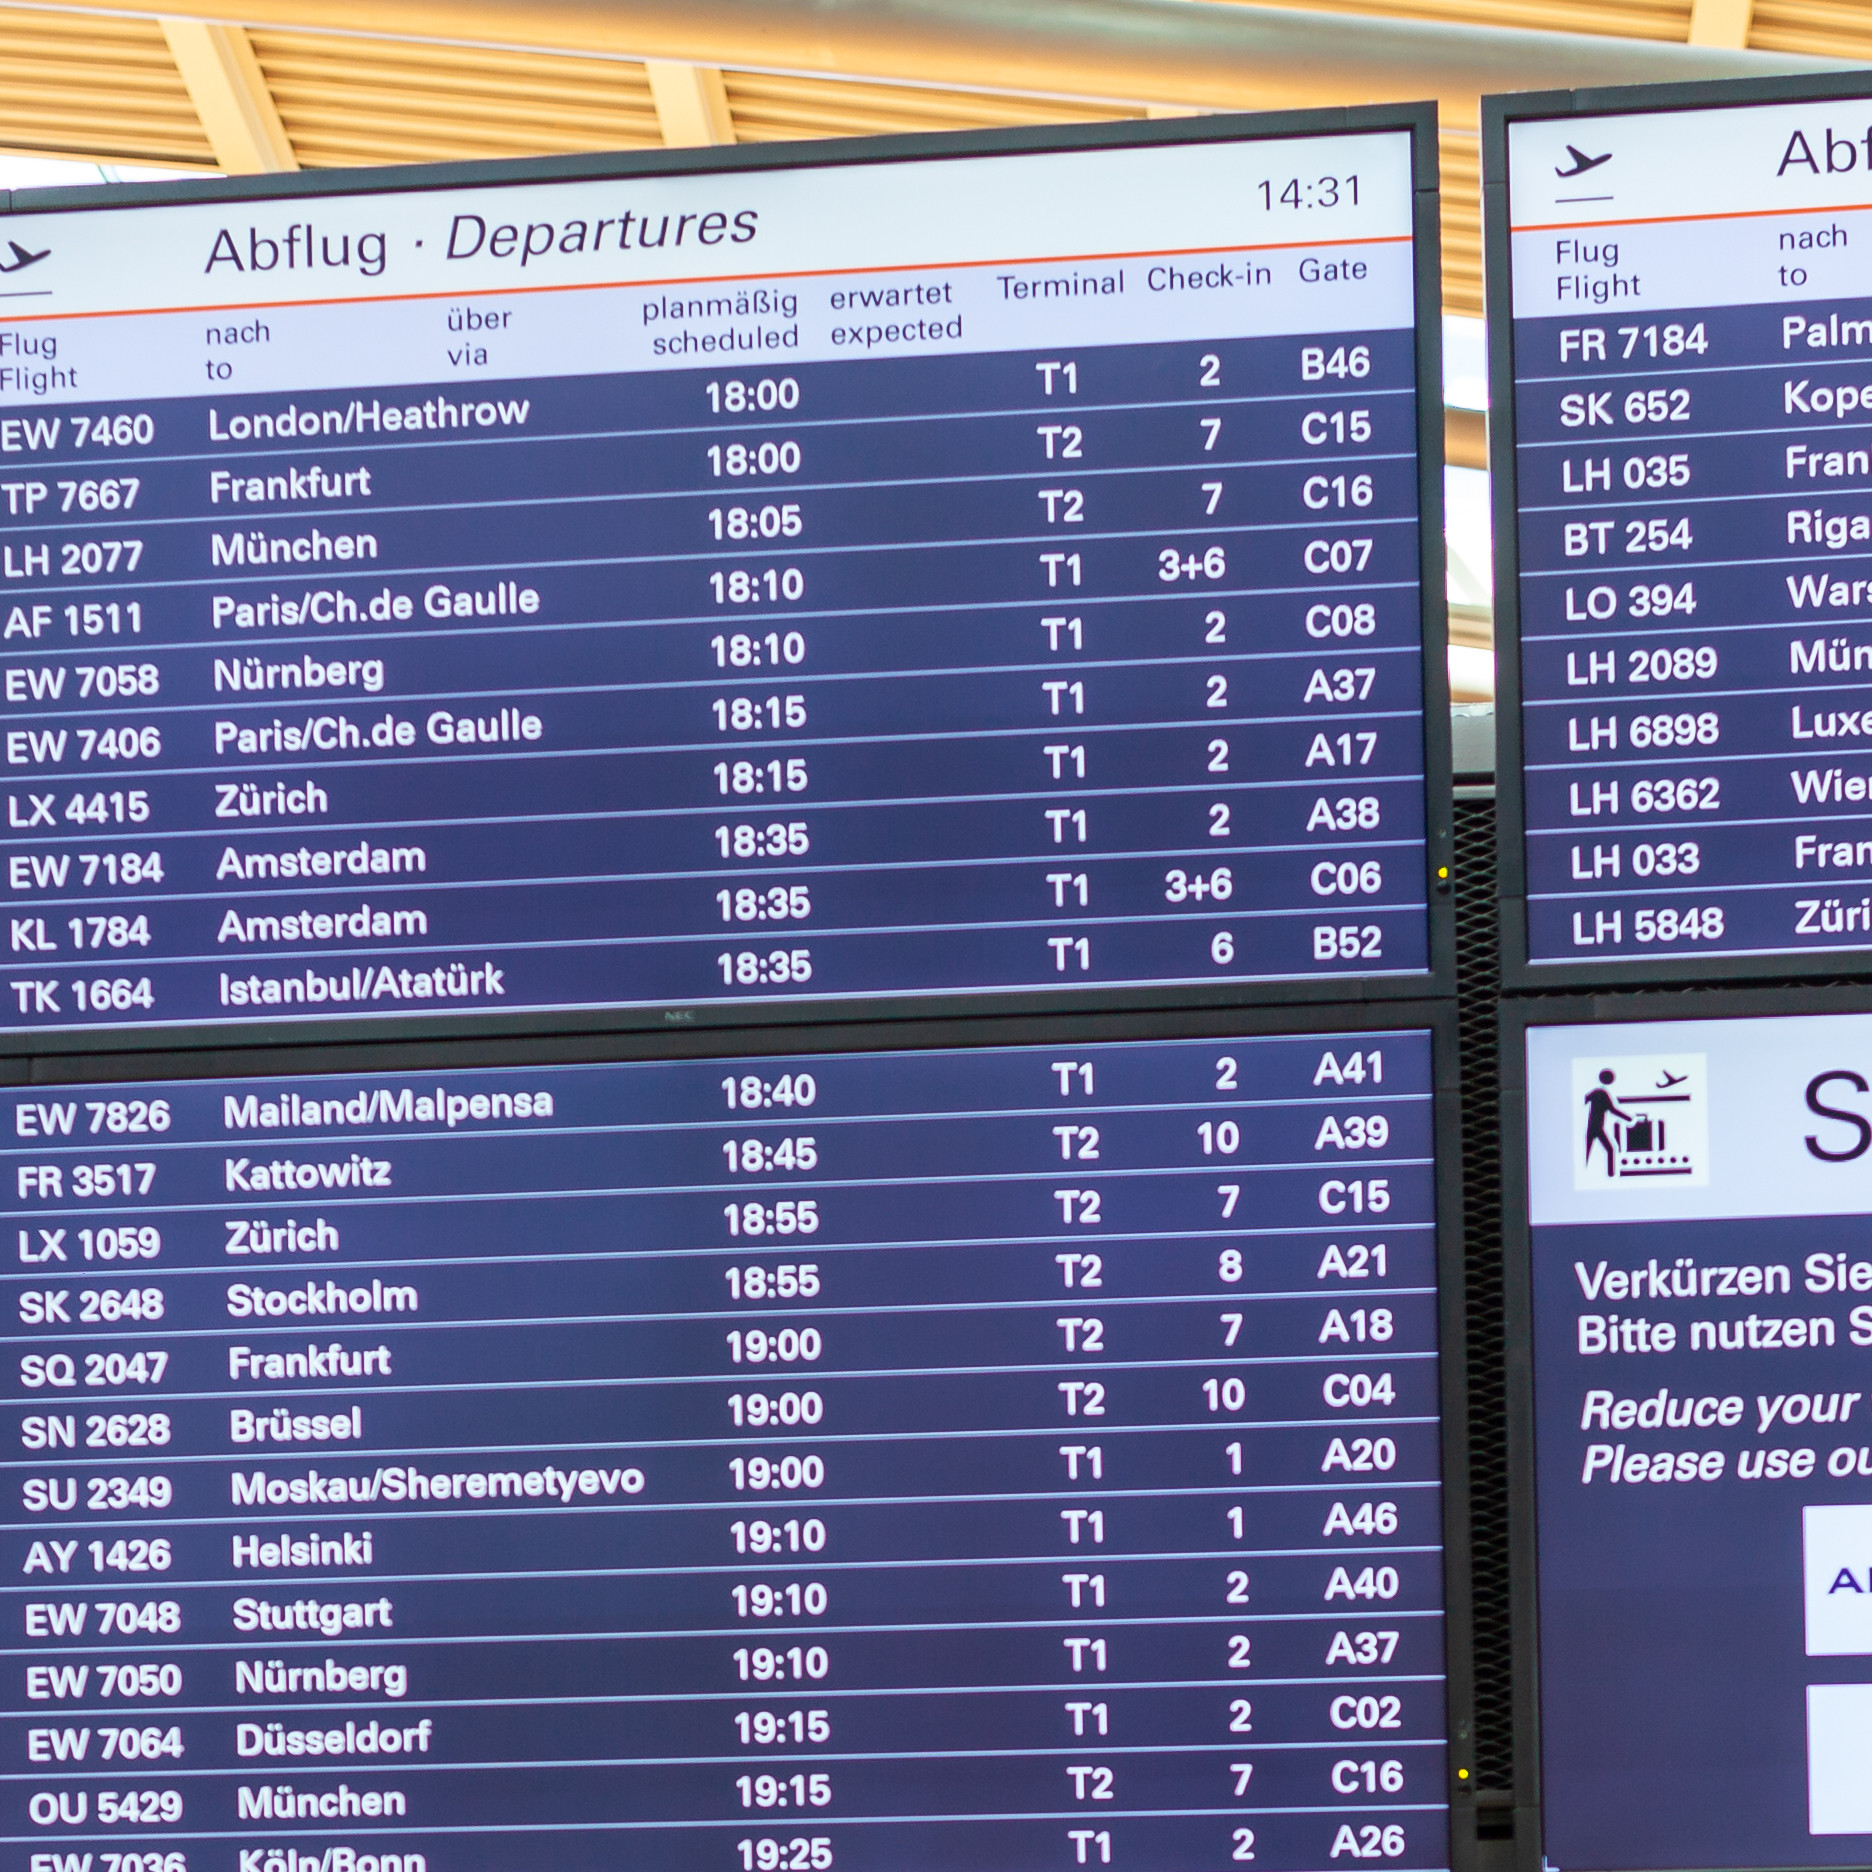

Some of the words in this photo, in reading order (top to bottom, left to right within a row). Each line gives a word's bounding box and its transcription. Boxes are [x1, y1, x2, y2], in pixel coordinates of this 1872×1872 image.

[204, 223, 386, 277] Abflug
[446, 209, 759, 267] Departures
[1258, 174, 1358, 211] 14:31
[206, 318, 270, 346] nach
[447, 306, 512, 332] über
[642, 289, 798, 327] planmäßig
[829, 281, 953, 310] erwartet
[996, 268, 1124, 300] Terminal
[1147, 261, 1271, 292] Check-in
[1298, 257, 1368, 283] Gate
[1568, 716, 1617, 751] LH
[1629, 712, 1720, 748] 6898
[10, 980, 61, 1013] TK
[71, 977, 155, 1011] 1664
[220, 961, 504, 1006] Istanbul/Atatürk
[718, 949, 812, 984] 18:35
[1048, 937, 1089, 971] T1
[1211, 931, 1234, 964] 6
[1313, 925, 1382, 960] B52
[1574, 1258, 1791, 1301] Verkürzen
[1578, 1314, 1676, 1355] Bitte
[1690, 1314, 1835, 1351] nutzen
[1581, 1388, 1744, 1430] Reduce
[1757, 1392, 1862, 1434] your
[22, 1478, 78, 1511] SU
[87, 1476, 173, 1510] 2349
[231, 1466, 645, 1505] Moskau/Sheremetyevo
[729, 1455, 824, 1490] 19:00
[1059, 1445, 1102, 1480] T1
[1225, 1442, 1242, 1475] 1
[1321, 1437, 1396, 1472] A20
[1582, 1444, 1726, 1484] Please
[1737, 1448, 1816, 1479] use
